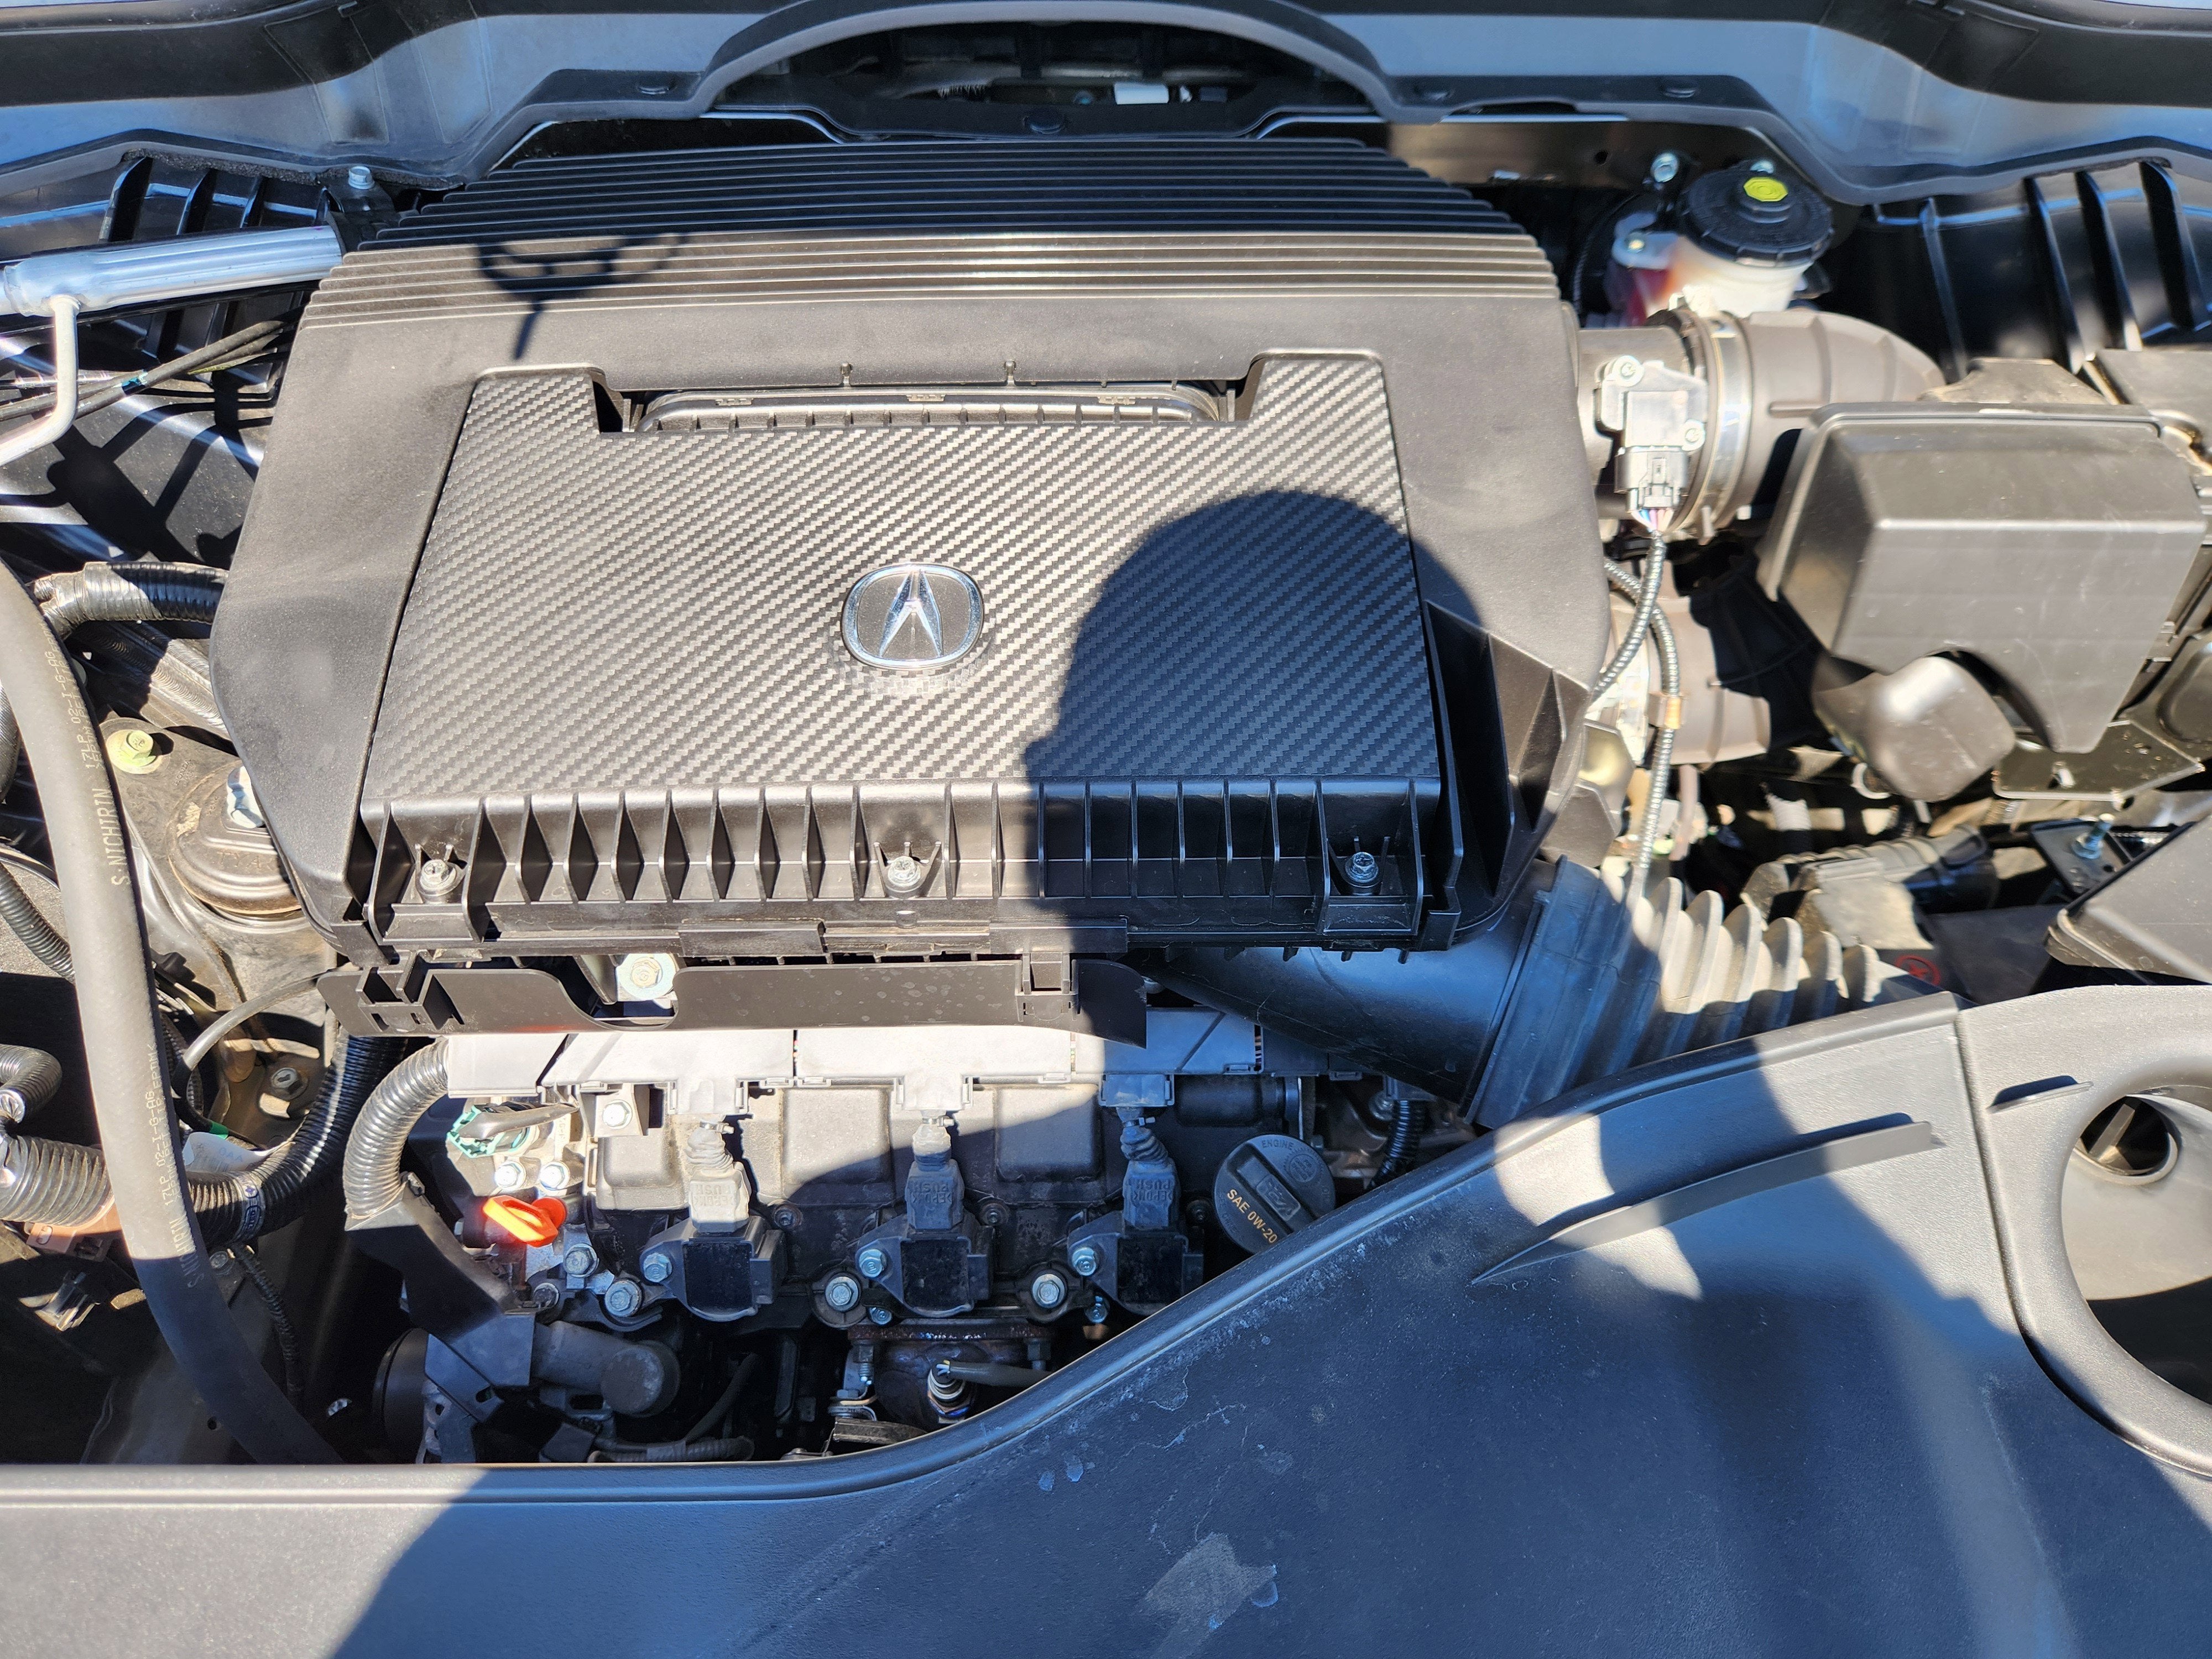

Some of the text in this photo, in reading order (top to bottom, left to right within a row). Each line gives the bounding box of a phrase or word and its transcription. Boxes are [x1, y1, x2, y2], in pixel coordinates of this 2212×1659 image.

[76, 734, 96, 769] 17LP
[1261, 1138, 1295, 1151] ENGINE
[159, 1175, 174, 1206] 17LP
[1227, 1188, 1251, 1214] SAE
[1246, 1211, 1278, 1244] 0W-20
